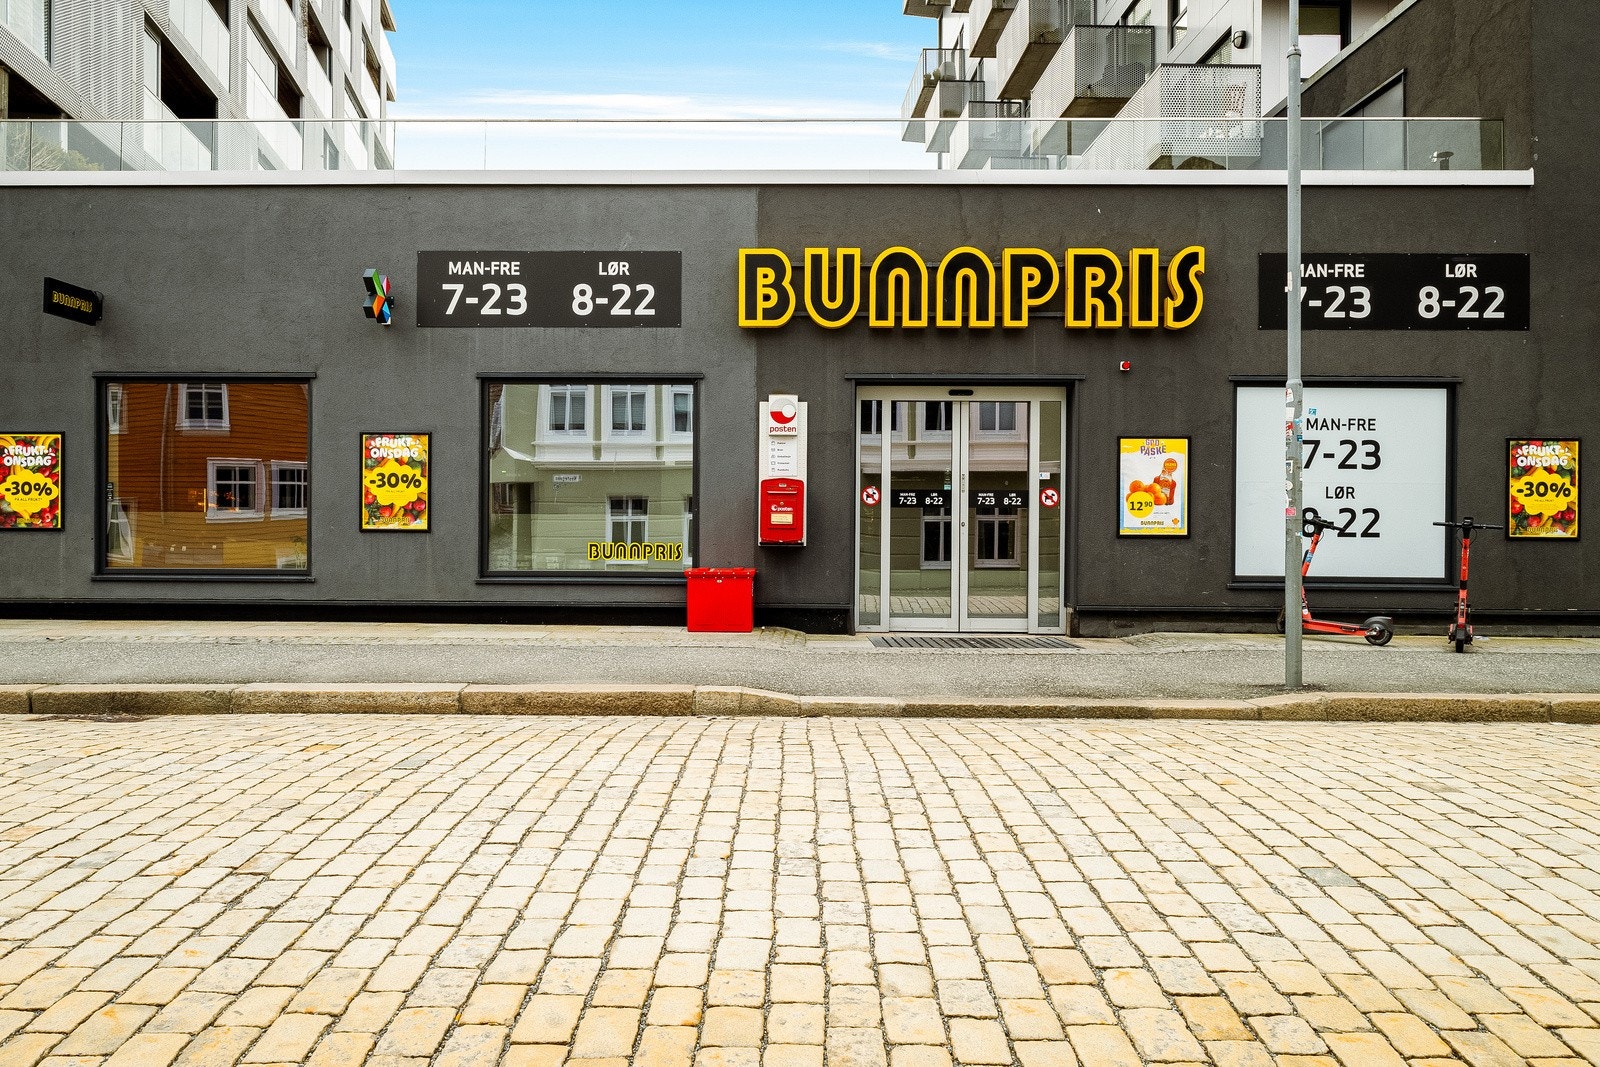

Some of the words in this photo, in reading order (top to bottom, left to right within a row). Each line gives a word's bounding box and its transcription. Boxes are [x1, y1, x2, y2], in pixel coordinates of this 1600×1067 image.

[448, 261, 521, 276] MAN-FRE
[598, 261, 630, 276] LØR
[1445, 263, 1478, 278] LØR
[738, 246, 1206, 329] BUNNPRIS
[442, 283, 528, 316] 7-23
[571, 283, 656, 316] 8-22
[1418, 285, 1506, 319] 8-22
[769, 425, 797, 434] posten
[1306, 418, 1377, 431] MAN-FRE
[370, 447, 419, 459] ONSDAG
[1302, 439, 1382, 470] 7-23
[3, 455, 52, 467] ONSDAG
[1516, 456, 1568, 467] ONSDAG
[369, 472, 422, 489] -30%
[4, 481, 53, 496] -30%
[1325, 486, 1356, 500] LØR
[1516, 481, 1571, 498] -30%
[898, 497, 917, 505] 7-23
[925, 497, 943, 505] 8-22
[977, 497, 995, 505] 7-23
[1003, 497, 1022, 505] 8-22
[1129, 501, 1143, 511] 12
[1302, 507, 1381, 538] 822
[587, 542, 683, 561] BUNNPRIS
